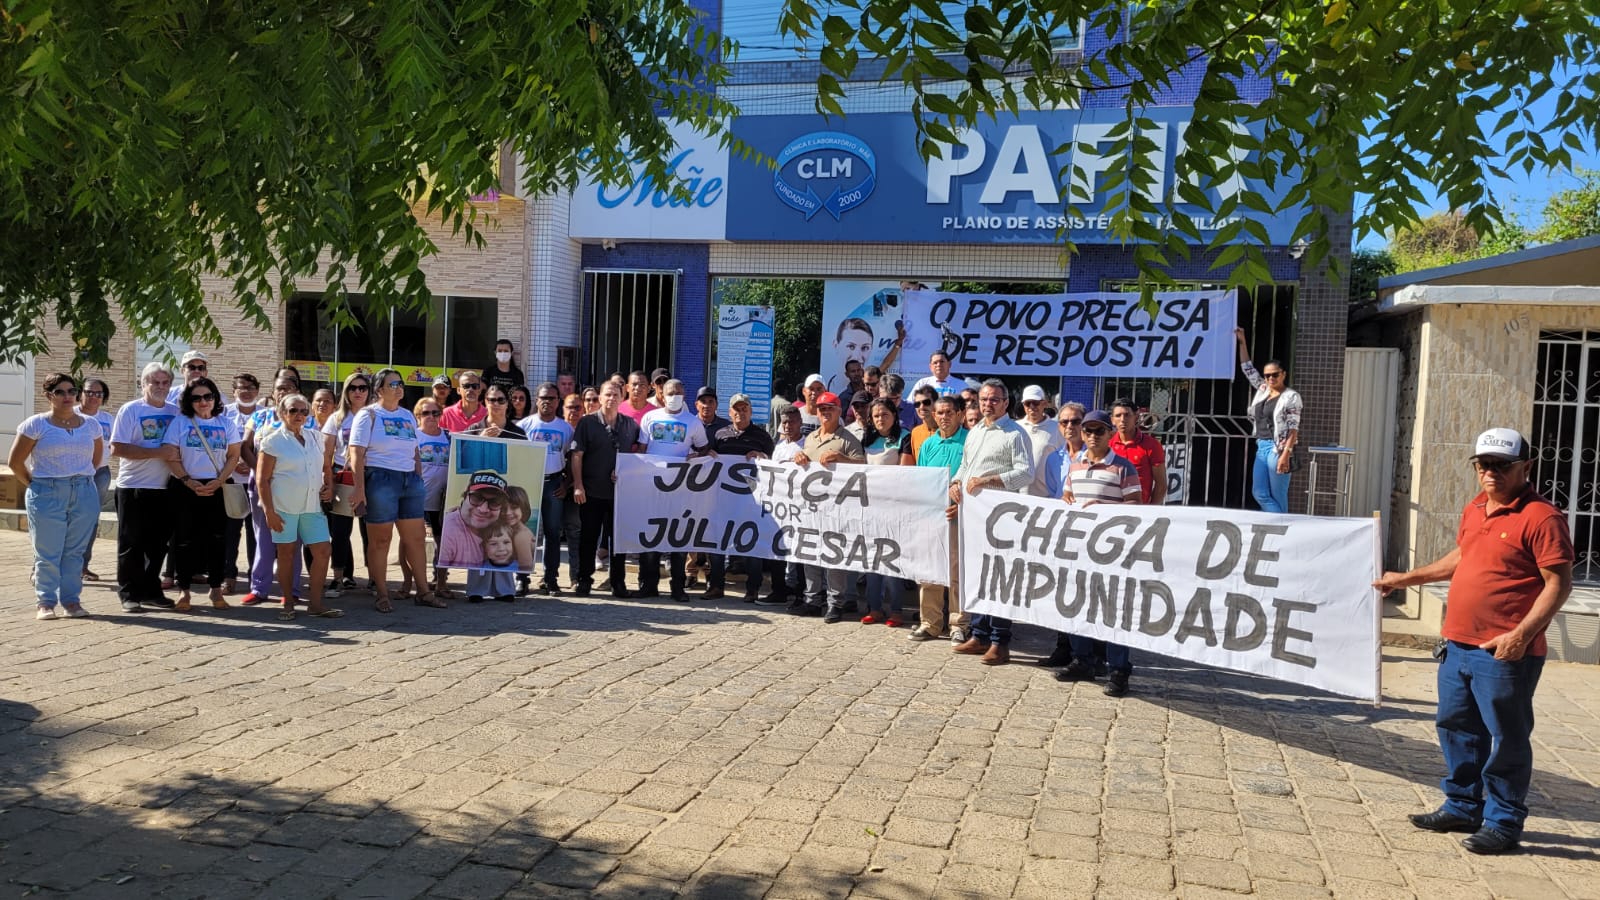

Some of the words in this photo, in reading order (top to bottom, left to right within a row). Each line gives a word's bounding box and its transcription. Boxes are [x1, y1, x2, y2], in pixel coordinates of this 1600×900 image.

[797, 157, 852, 179] CLM
[775, 181, 805, 206] FUNDADO
[804, 200, 815, 209] EM
[838, 190, 862, 207] 2000
[942, 216, 1003, 229] PLANO
[1006, 216, 1028, 229] DE
[1034, 213, 1150, 230] ASSISTÊ
[930, 298, 957, 330] O
[962, 299, 1050, 331] POVO
[1057, 298, 1210, 333] PRECISA
[942, 333, 981, 363] DE
[991, 333, 1204, 369] RESPOSTA!
[760, 500, 802, 523] POR
[638, 509, 760, 554] JÚLIO
[771, 523, 901, 573] CESAR
[985, 501, 1171, 573] CHEGA
[1195, 519, 1289, 588] DE
[978, 552, 1318, 670] IMPUNIDADE
